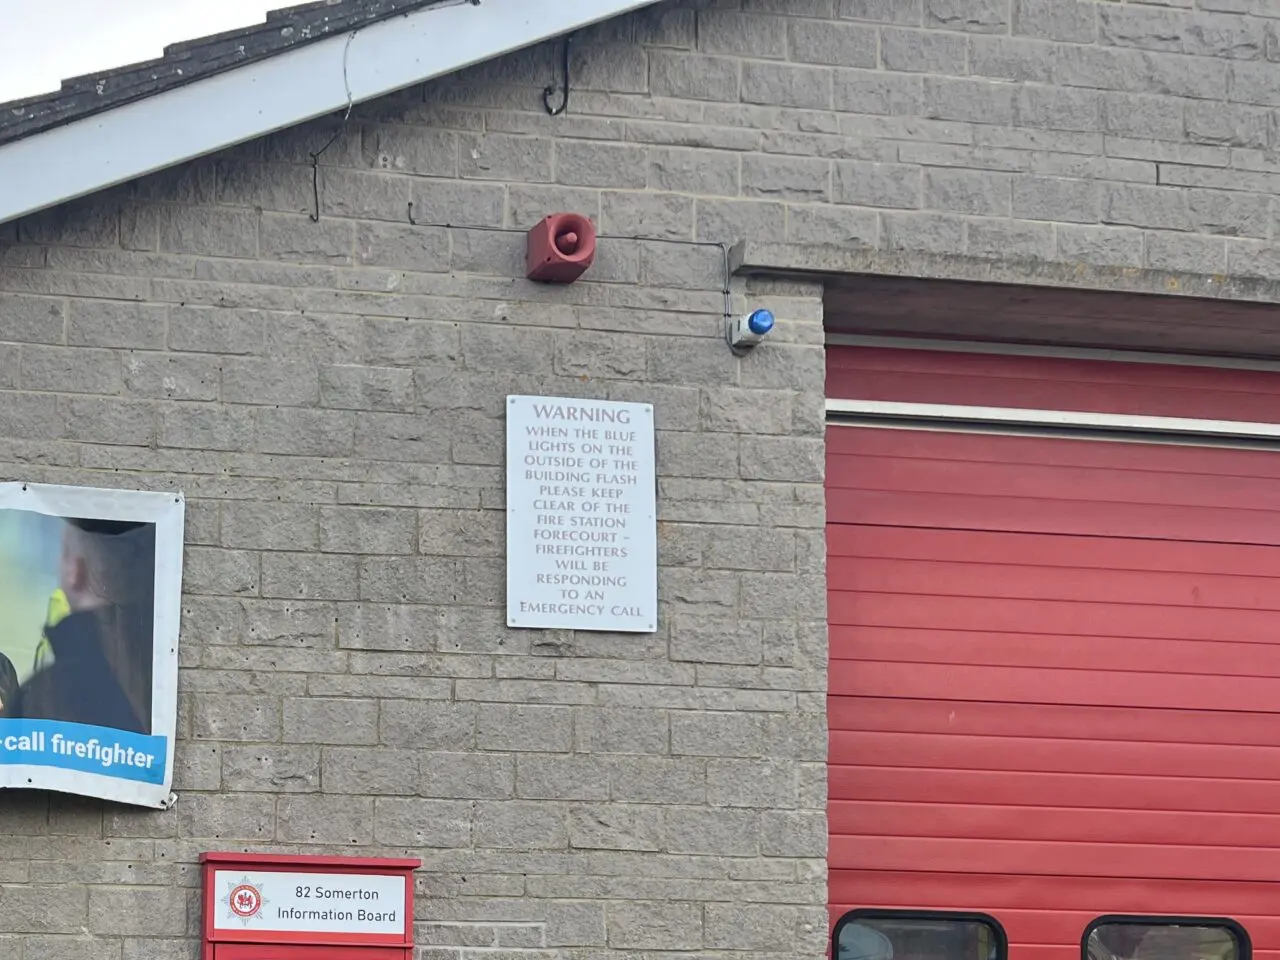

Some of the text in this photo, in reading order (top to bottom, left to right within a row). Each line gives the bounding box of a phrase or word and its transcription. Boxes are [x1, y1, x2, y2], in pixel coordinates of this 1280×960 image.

[533, 404, 631, 424] WARNING
[525, 425, 637, 442] WHEN THE BLUE
[528, 441, 633, 456] LIGHTS ON THE
[524, 455, 639, 471] OUTSIDE OF THE
[525, 469, 637, 485] BUILDING FLASH
[539, 486, 624, 499] PLEASE KEEP
[533, 499, 631, 514] CLEAR OF THE
[537, 515, 626, 528] FIRE STATION
[533, 529, 617, 543] FORECOURT
[535, 544, 628, 558] FIREFIGHTERS
[555, 559, 609, 571] WILL BE
[536, 573, 627, 587] RESPONDING
[560, 589, 604, 601] TO AN
[520, 601, 644, 617] EMERGENCY CALL
[51, 735, 154, 769] firefighter
[295, 886, 379, 900] 82 Somerton
[277, 907, 396, 922] Information Board
